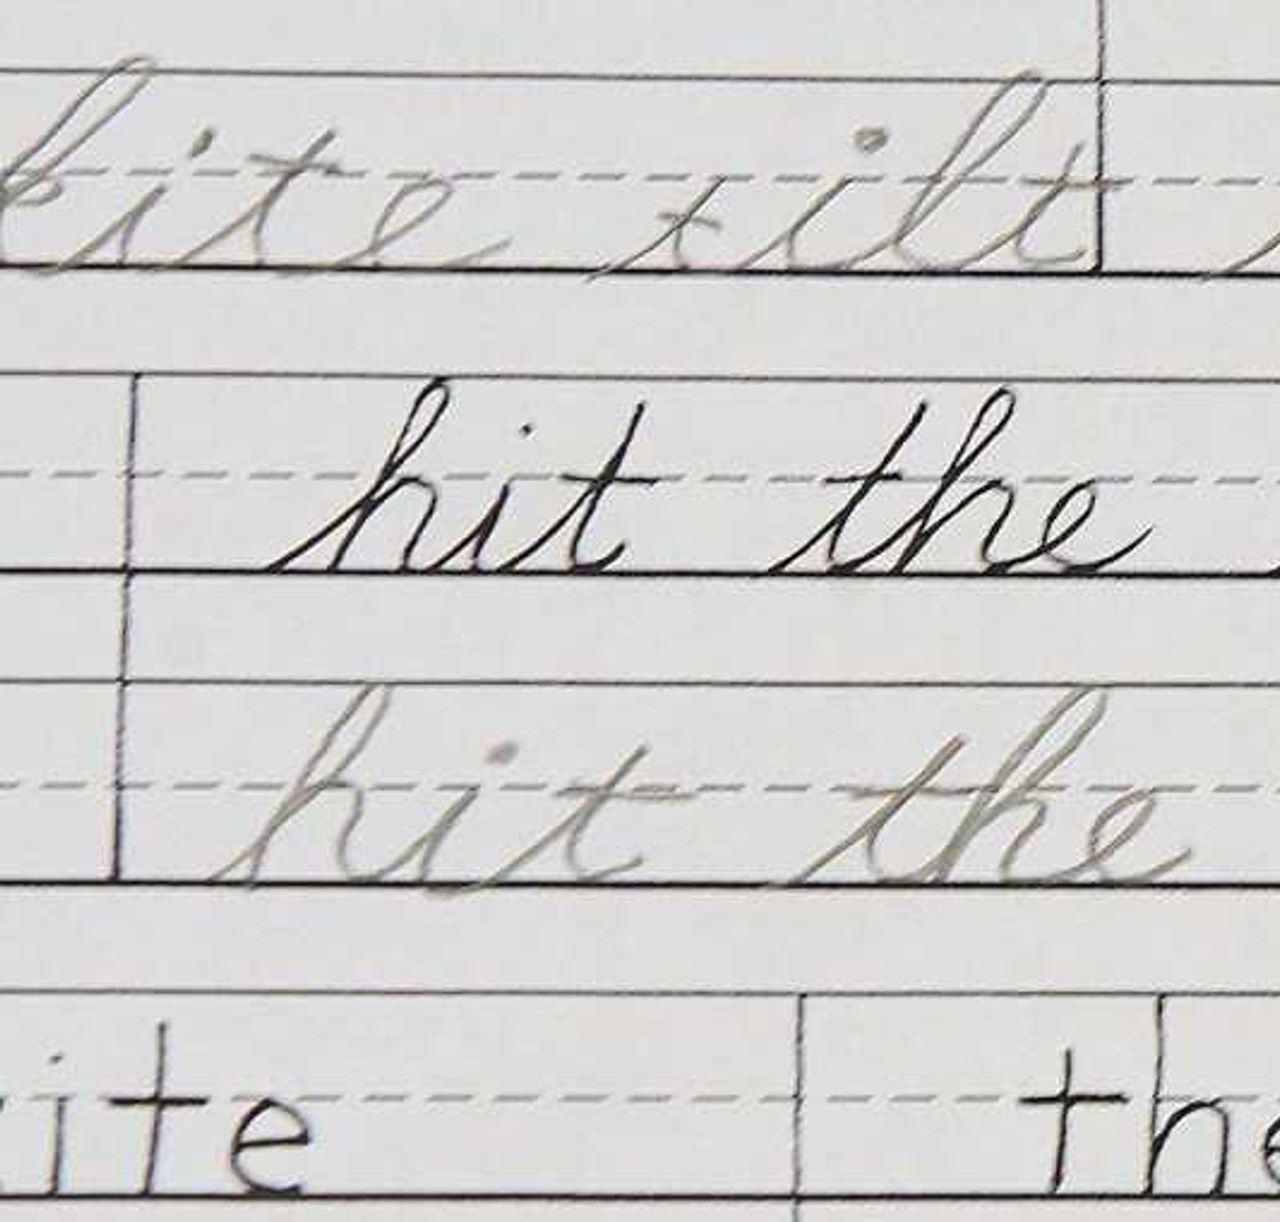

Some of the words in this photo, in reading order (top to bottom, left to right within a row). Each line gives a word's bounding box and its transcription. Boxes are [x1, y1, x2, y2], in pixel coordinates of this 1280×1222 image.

[264, 376, 661, 576] hit
[767, 384, 1153, 577] the
[204, 683, 697, 899] hit
[770, 683, 1192, 888] the
[0, 1019, 311, 1196] ite
